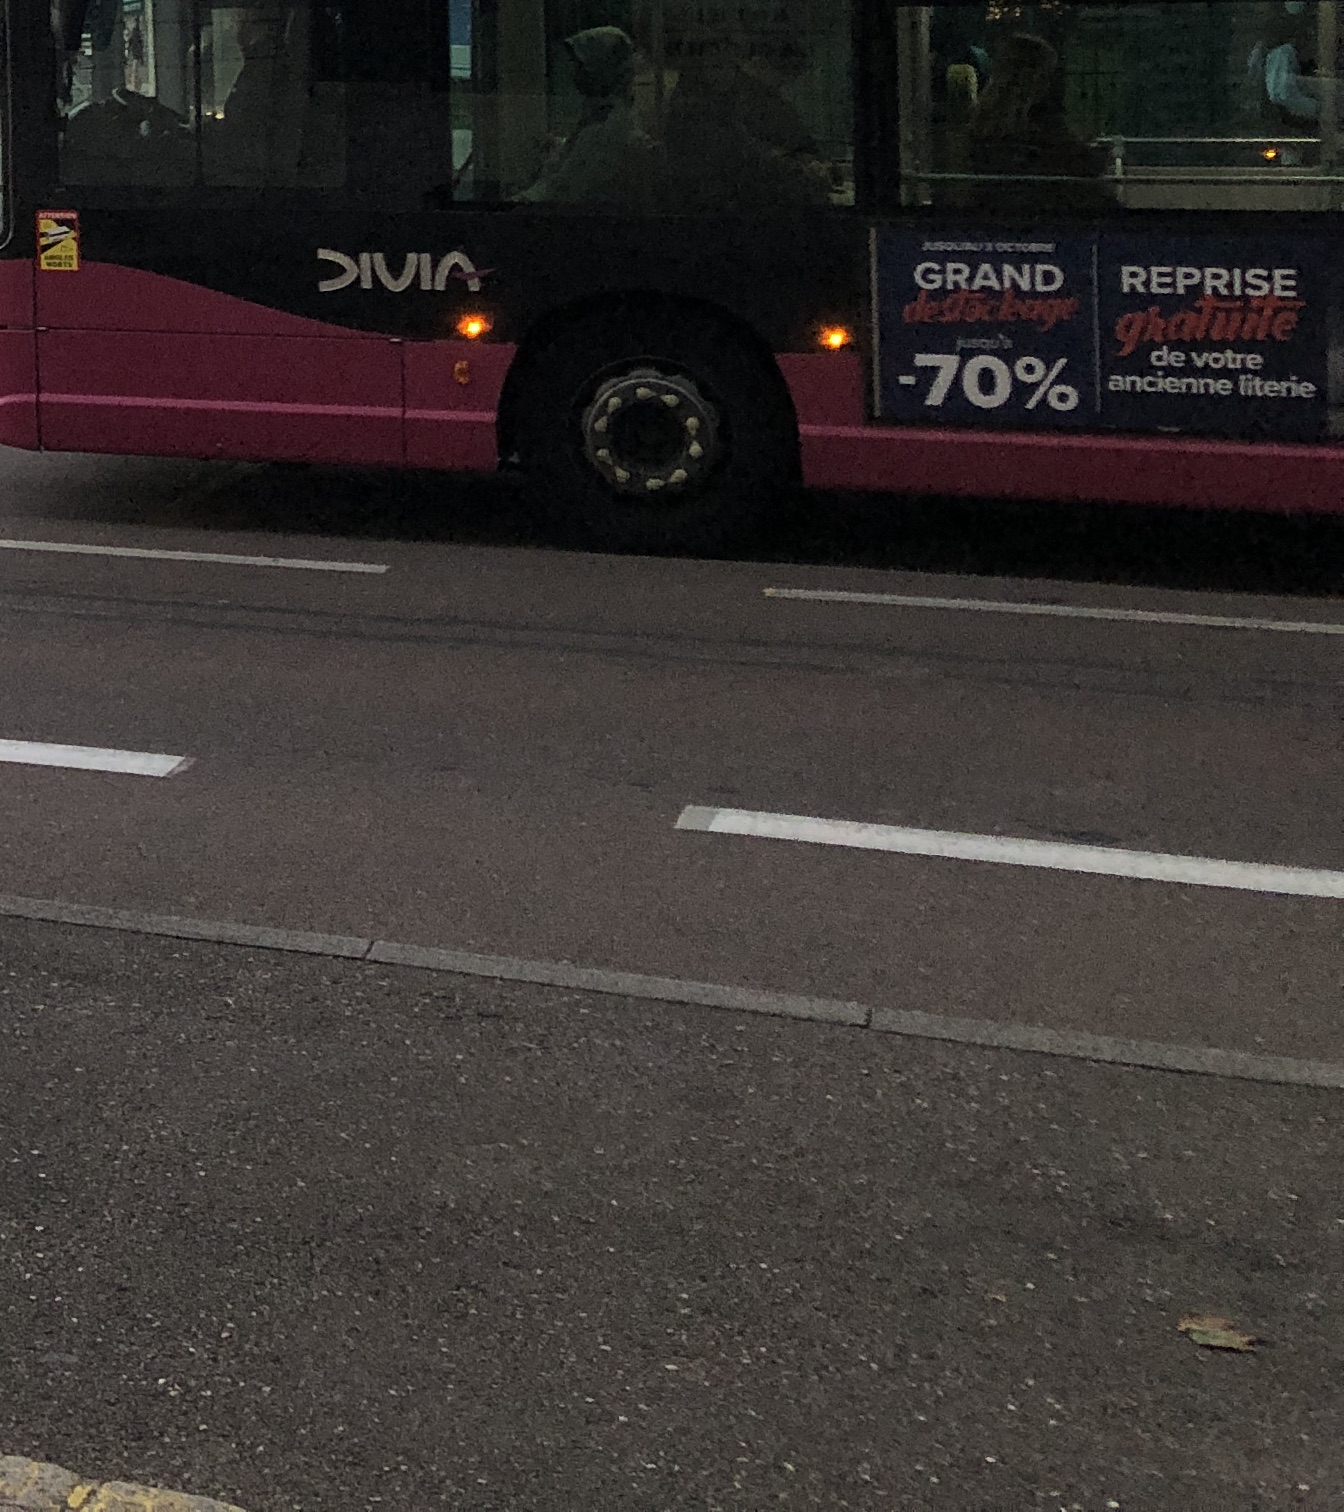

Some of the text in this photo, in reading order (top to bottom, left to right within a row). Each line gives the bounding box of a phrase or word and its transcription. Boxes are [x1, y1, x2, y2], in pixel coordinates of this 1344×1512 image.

[317, 247, 496, 292] DIVIA
[914, 261, 1065, 292] GRAND
[1120, 265, 1299, 298] REPRISE
[1115, 295, 1306, 356] gratuite
[1150, 345, 1264, 371] de votre
[898, 353, 1080, 412] -70%
[1108, 373, 1318, 399] ancienne literie
